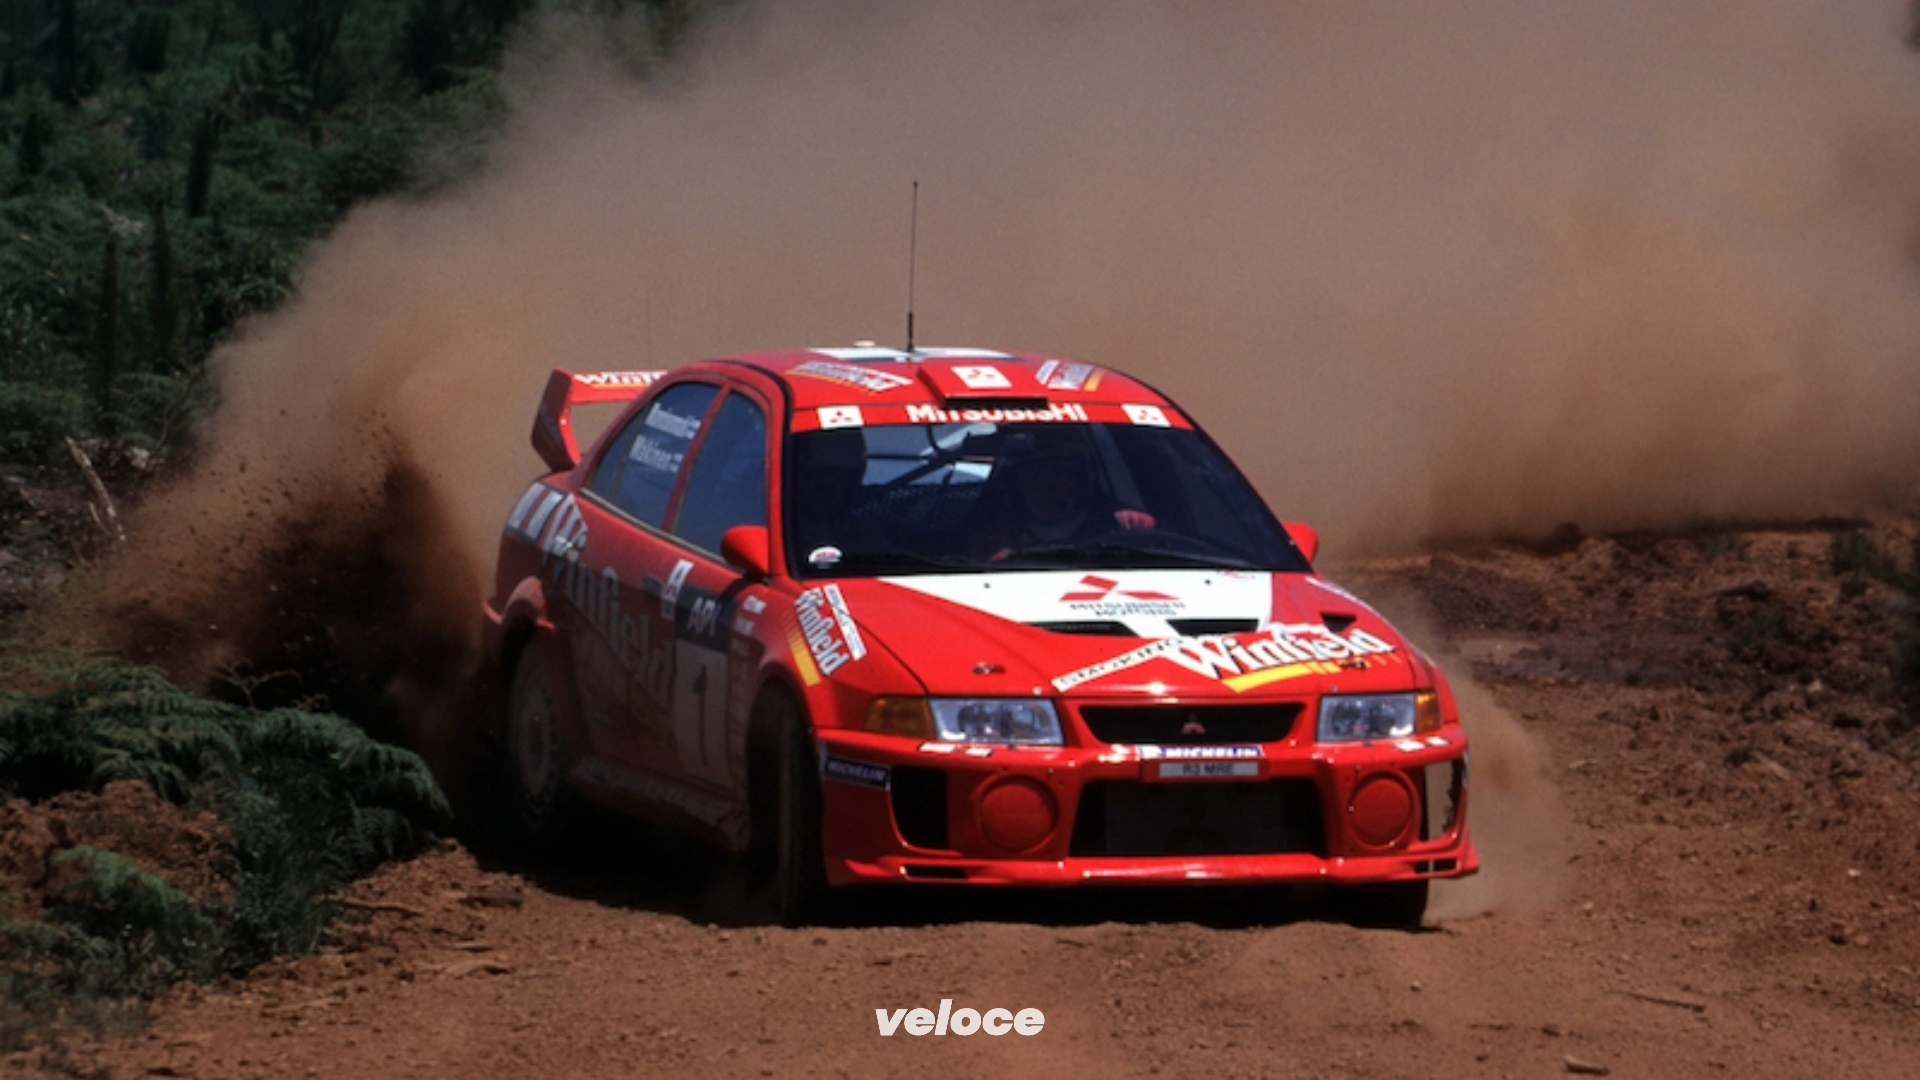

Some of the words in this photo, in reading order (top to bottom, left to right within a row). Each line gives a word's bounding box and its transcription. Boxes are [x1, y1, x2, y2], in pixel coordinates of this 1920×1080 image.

[793, 587, 850, 677] Winfield
[1163, 622, 1397, 680] Winfield
[827, 760, 887, 782] MICHELIN
[1165, 746, 1259, 759] MICHELIN
